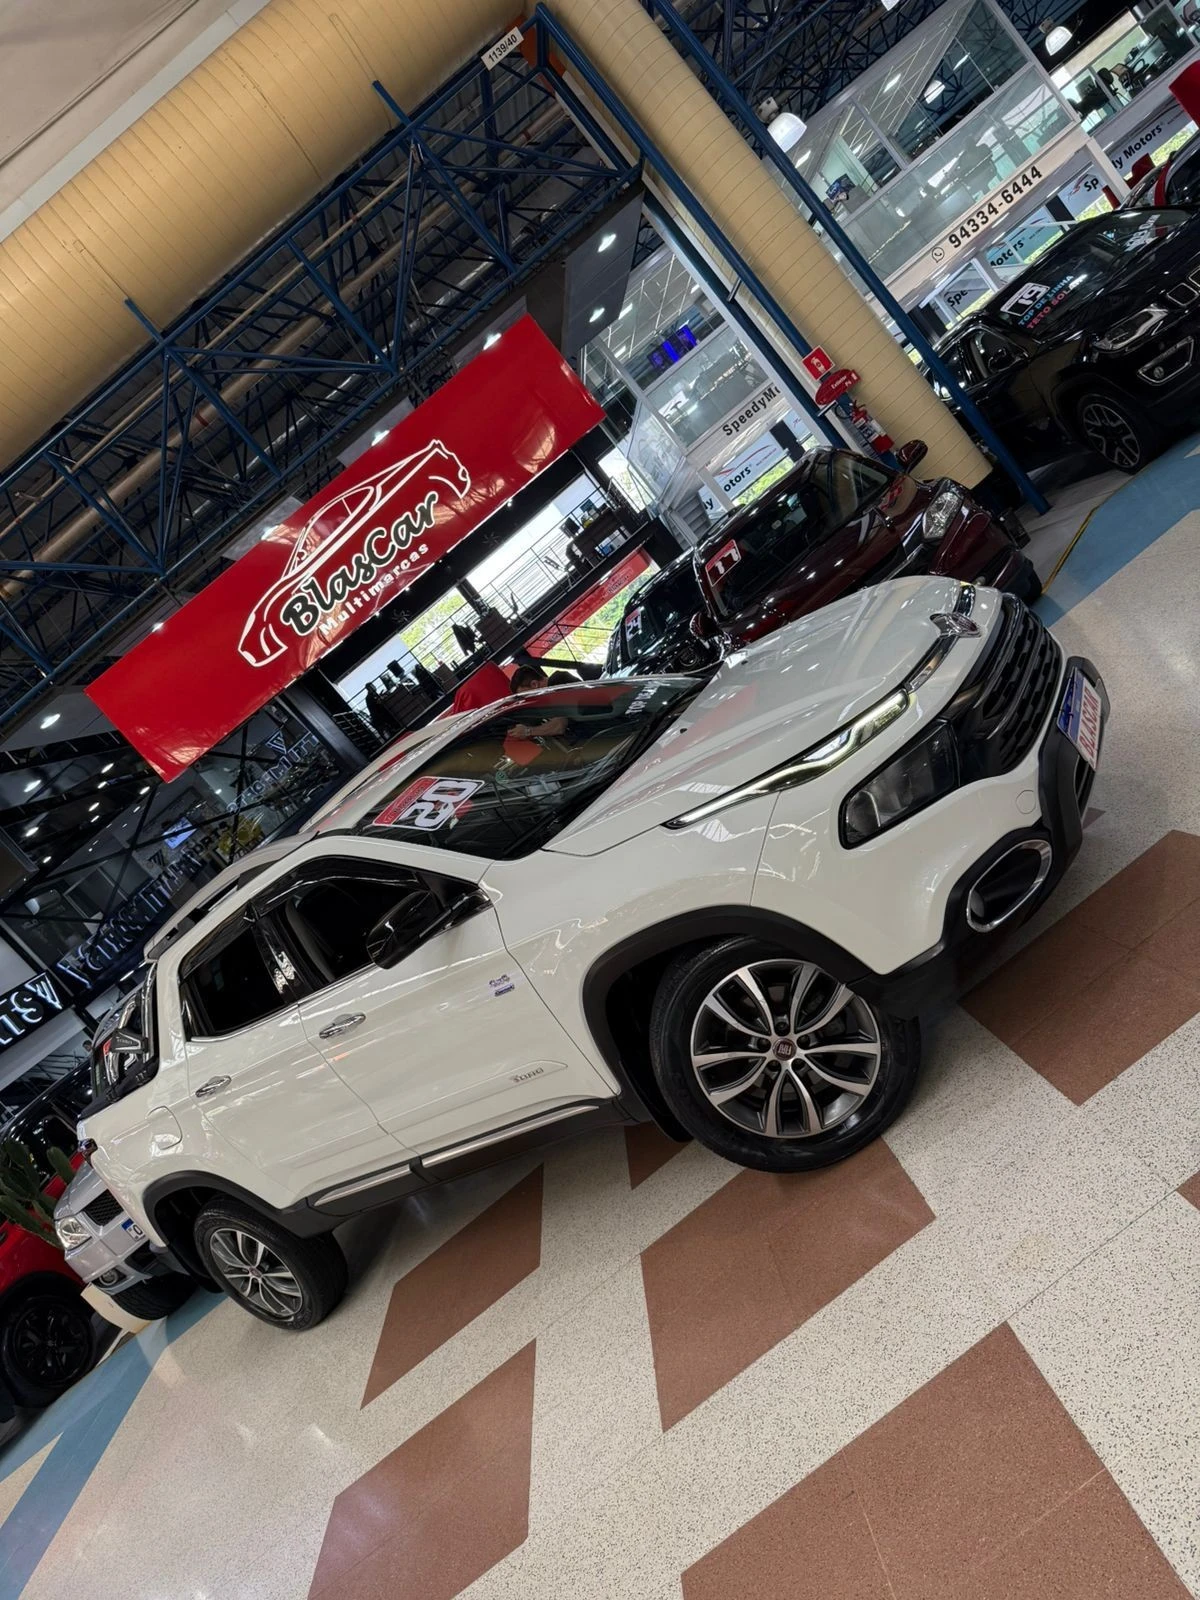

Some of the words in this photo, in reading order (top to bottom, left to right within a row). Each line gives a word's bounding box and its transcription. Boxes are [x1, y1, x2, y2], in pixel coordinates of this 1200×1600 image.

[487, 33, 518, 63] 1139/40
[1122, 123, 1163, 160] Motors
[948, 164, 1043, 249] 94334-6444
[1018, 310, 1034, 326] TOP
[1035, 298, 1049, 310] DE
[1049, 274, 1075, 299] LINHA
[1026, 305, 1052, 329] TETO
[279, 490, 439, 637] BlasCar
[318, 543, 429, 636] Multimarcas
[1078, 685, 1099, 758] BLASCAR
